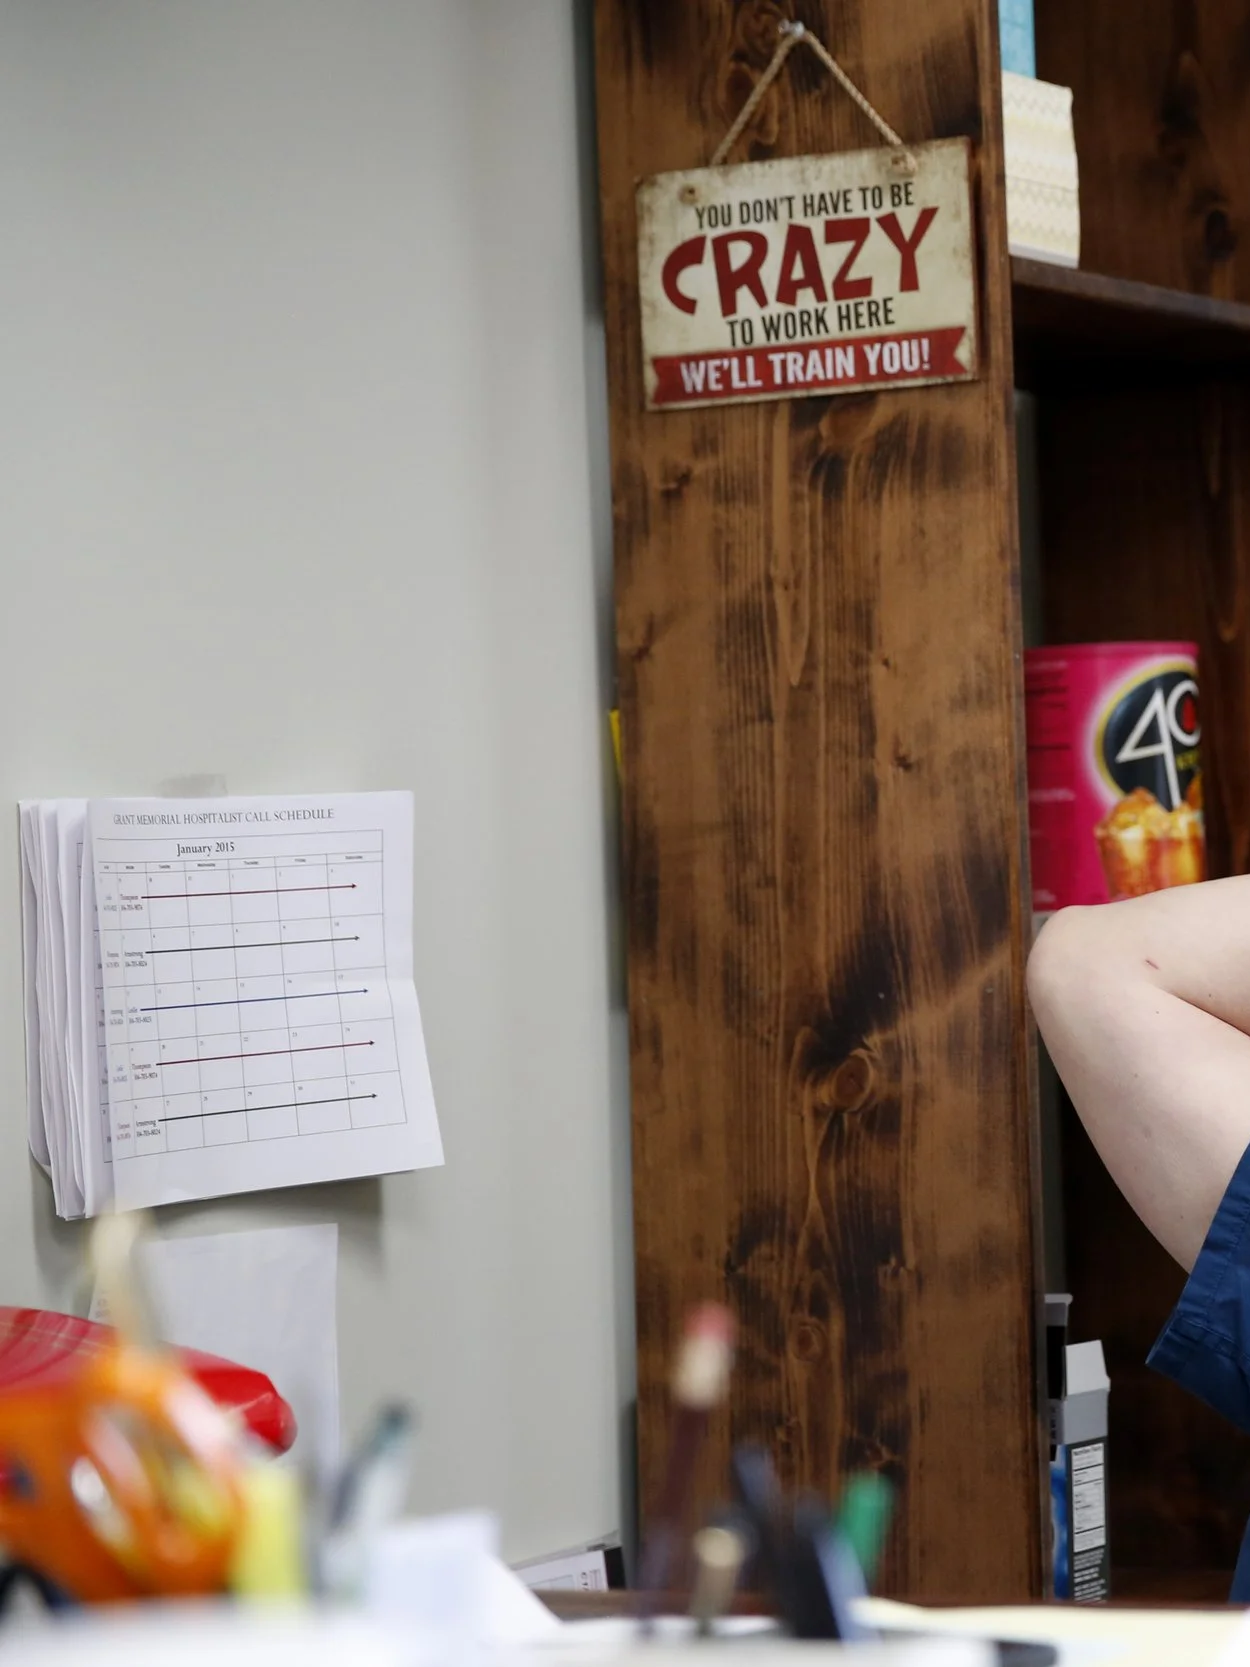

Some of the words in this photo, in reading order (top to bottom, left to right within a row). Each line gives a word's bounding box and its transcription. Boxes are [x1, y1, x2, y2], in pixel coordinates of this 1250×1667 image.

[695, 203, 736, 230] YOU
[739, 196, 795, 225] DON'T
[803, 189, 853, 219] HAVE
[859, 185, 884, 211] TO
[891, 182, 915, 207] BE
[661, 206, 940, 318] CRAZY
[726, 318, 753, 348] TO
[761, 307, 830, 342] WORK
[837, 298, 895, 333] HERE
[680, 356, 763, 394] WE'LL
[768, 345, 856, 386] TRAIN
[863, 338, 931, 376] YOU!
[113, 813, 135, 826] GRANT
[136, 813, 182, 826] MEMORIAL
[183, 811, 243, 825] HOSPITALIST
[245, 810, 271, 823] CALL
[273, 808, 335, 822] SCHEDULE
[176, 843, 212, 857] January
[215, 841, 236, 853] 2015
